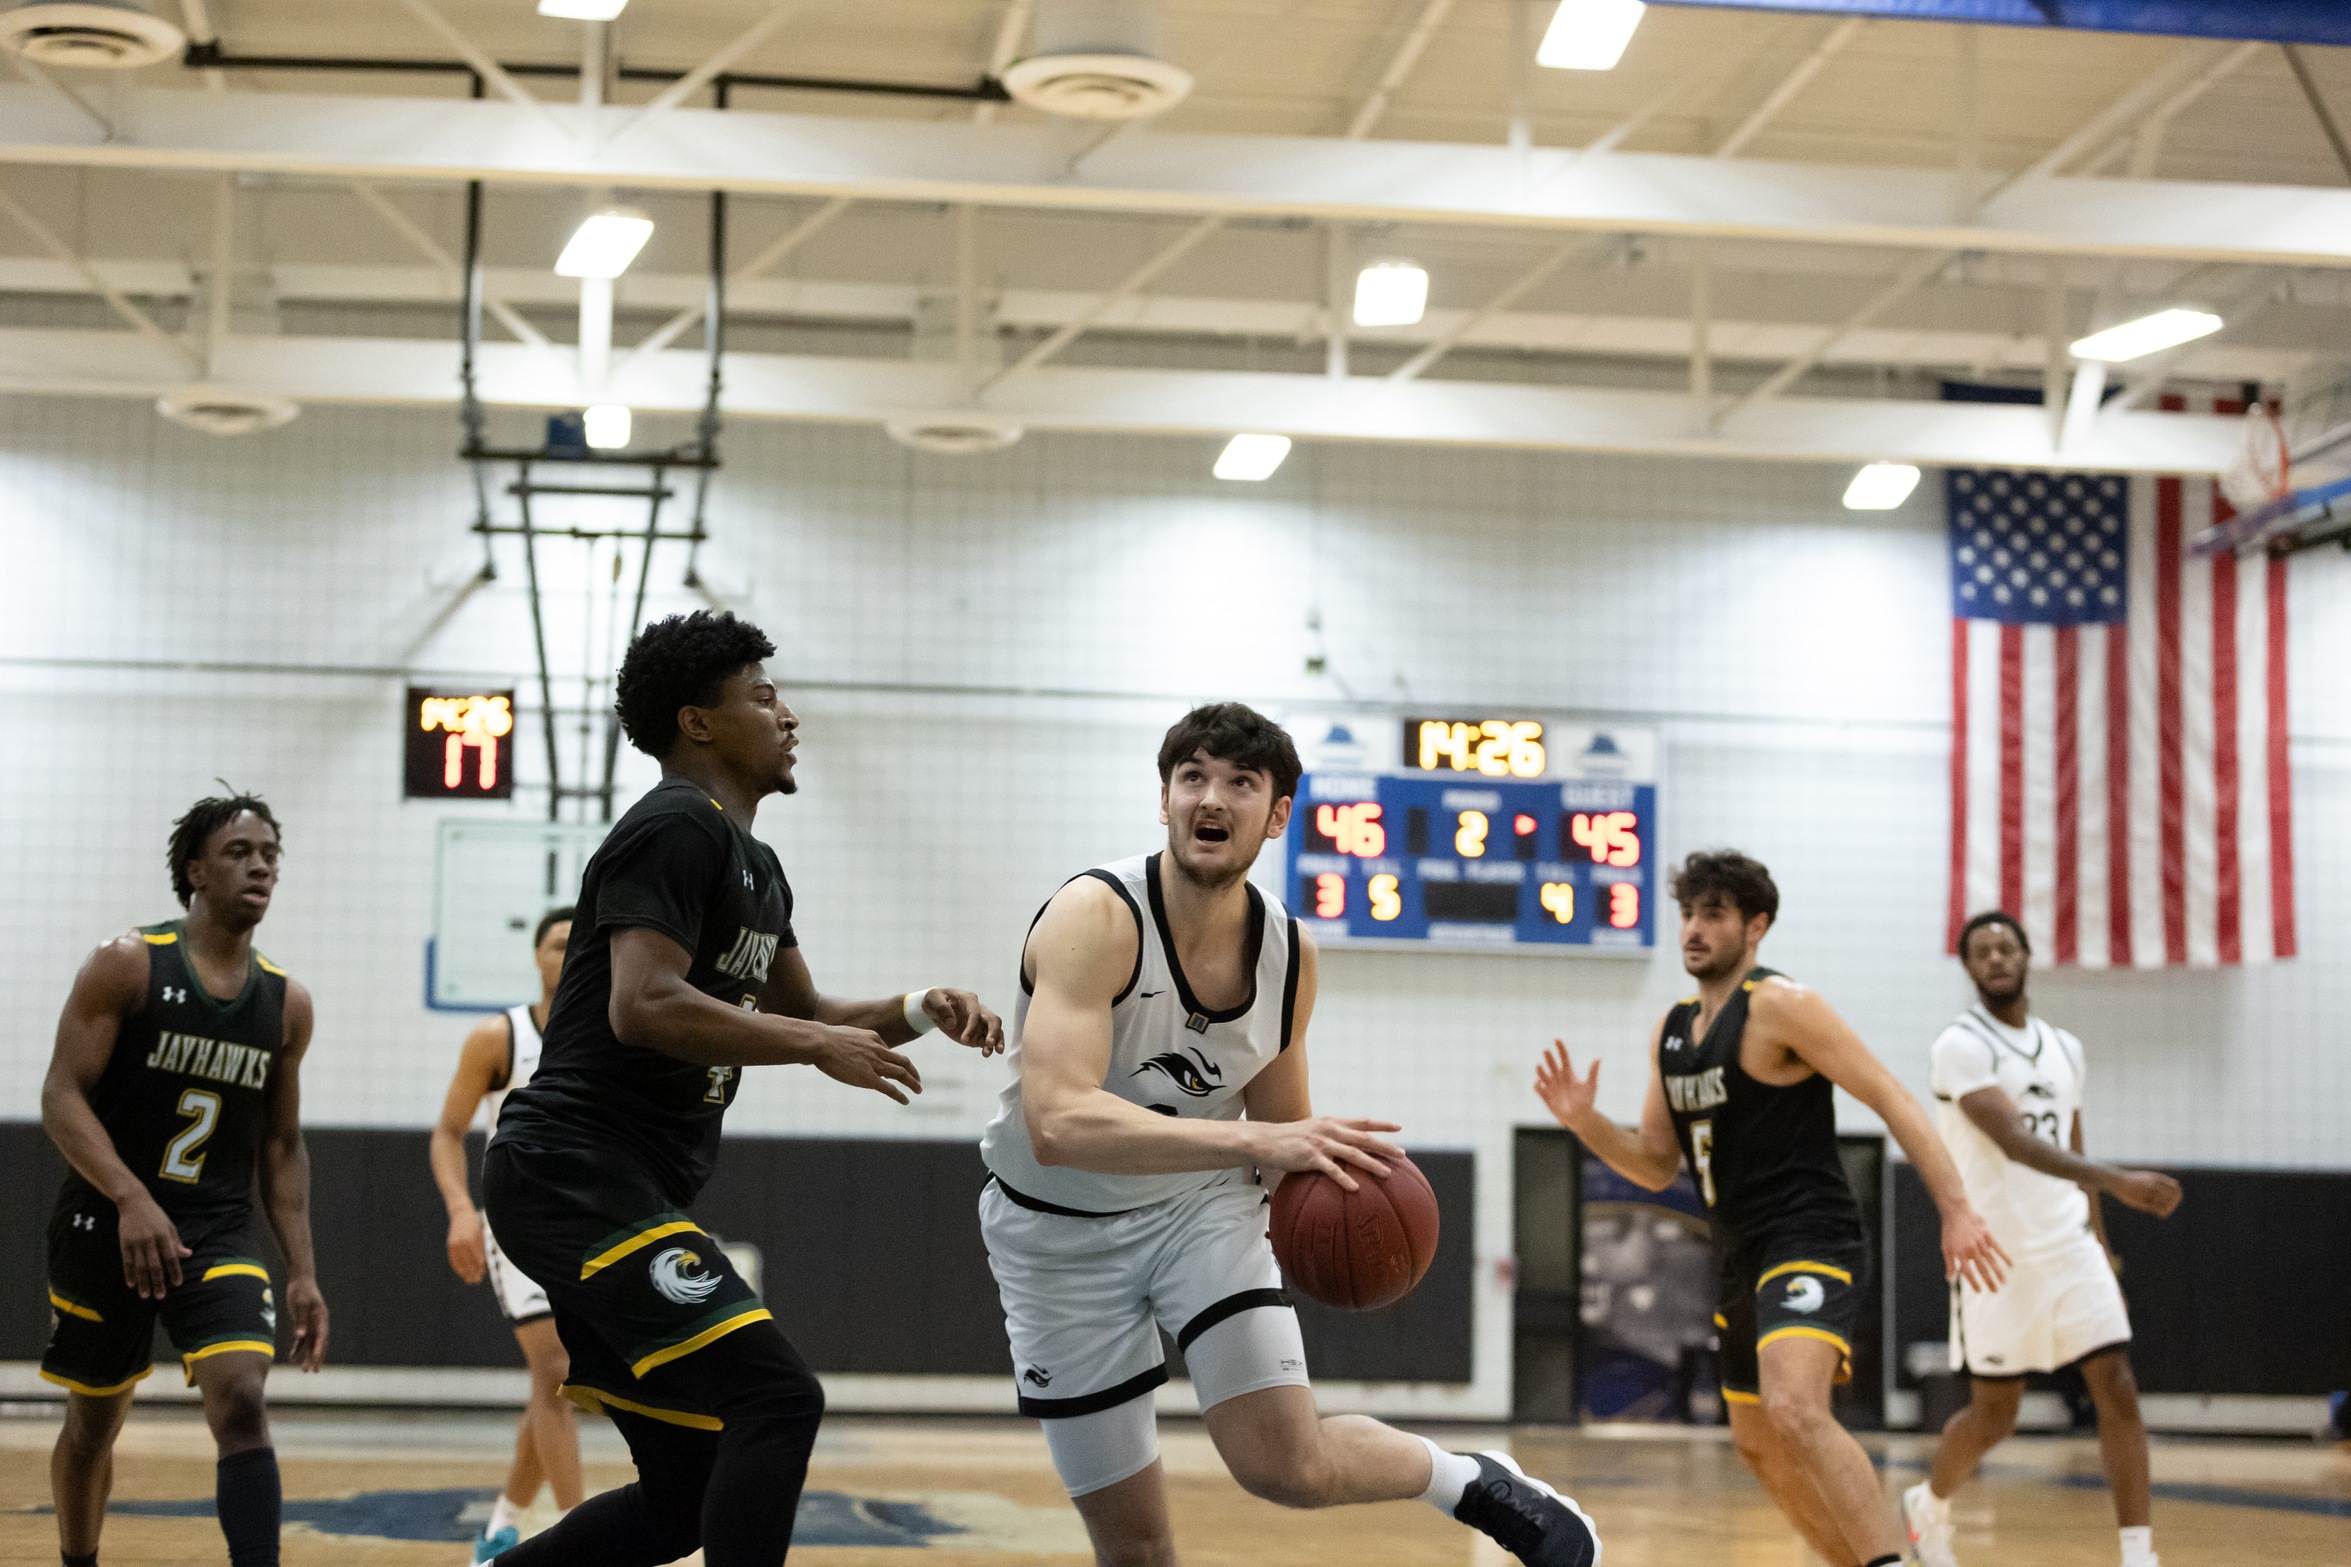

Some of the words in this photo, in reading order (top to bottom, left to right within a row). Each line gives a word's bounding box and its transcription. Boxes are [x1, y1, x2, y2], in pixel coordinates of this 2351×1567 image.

[445, 732, 497, 790] 17
[1419, 719, 1546, 778] 14:26
[1316, 802, 1385, 858] 46
[1455, 810, 1489, 857] 2
[1571, 811, 1640, 867] 45
[1316, 872, 1346, 919] 3
[1368, 873, 1401, 921] 5
[1540, 882, 1574, 924] 4
[1609, 882, 1639, 928] 3
[146, 1030, 272, 1091] JAYHAWKS
[158, 1088, 222, 1185] 2
[1690, 1119, 1717, 1208] 5
